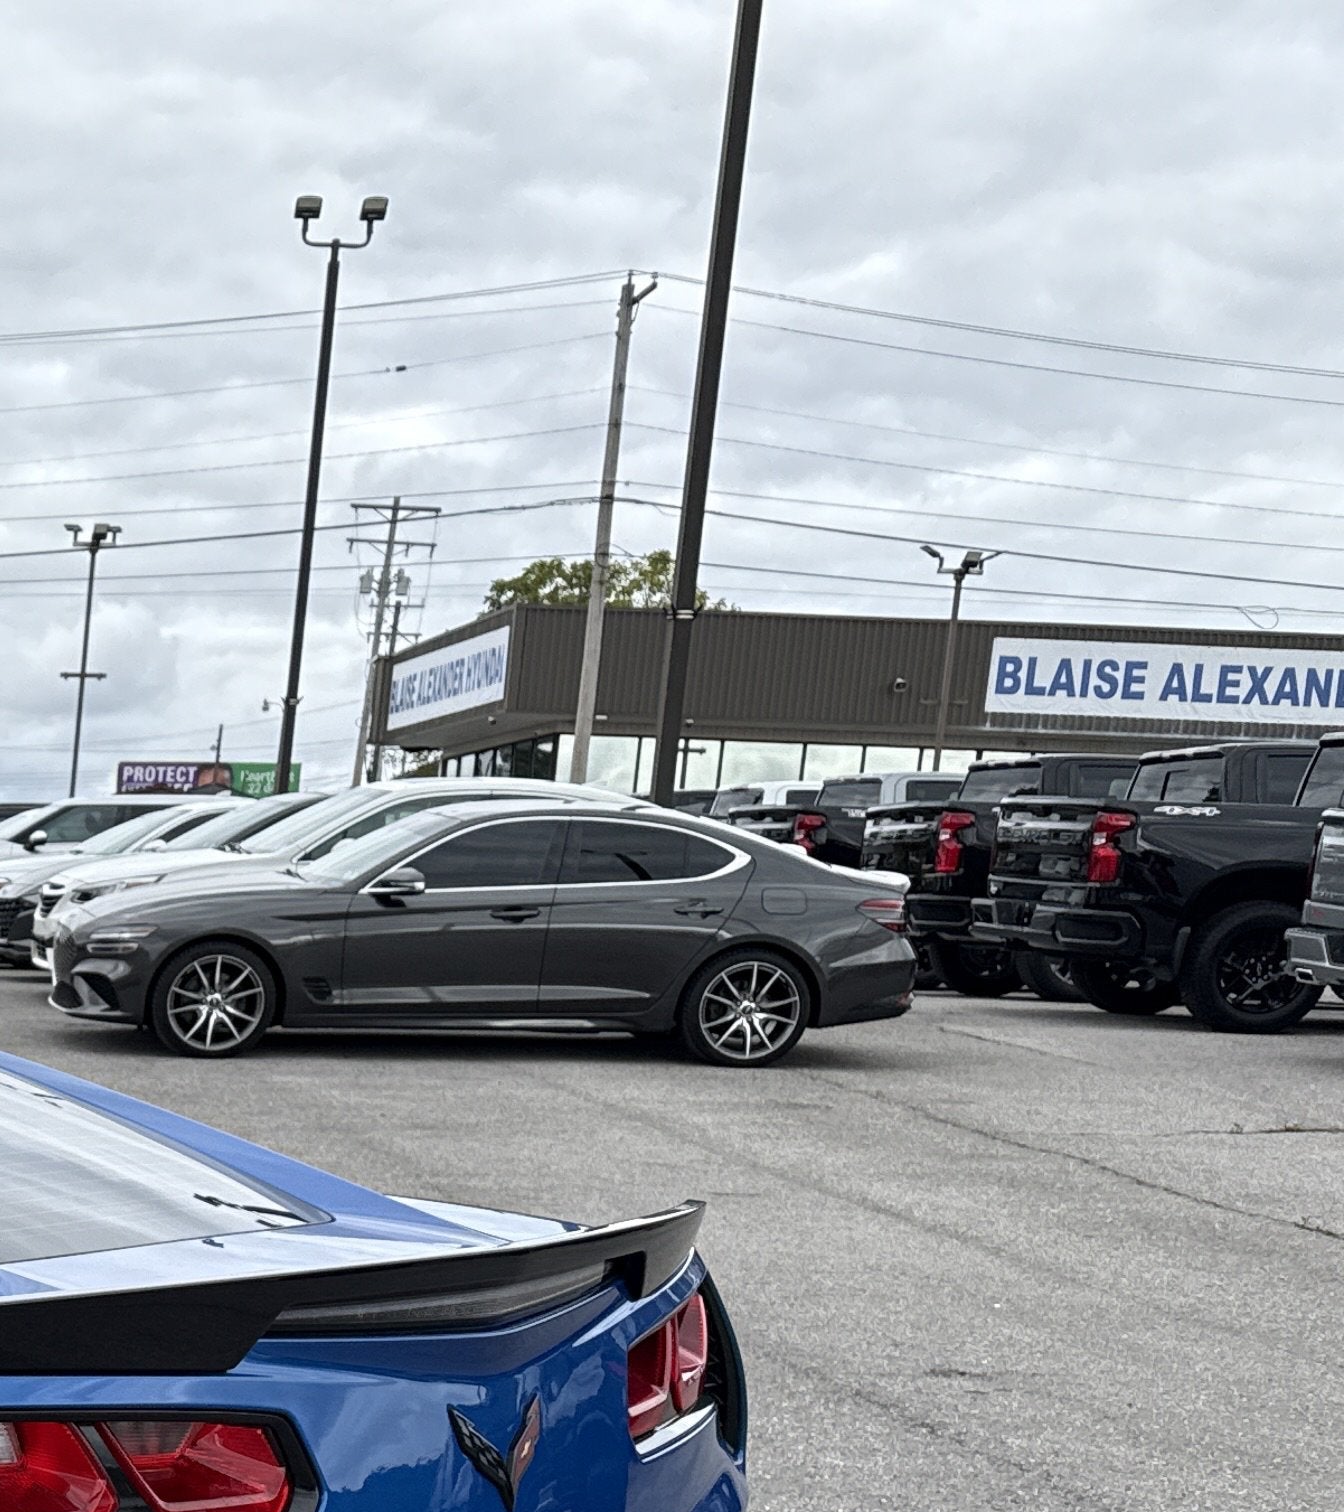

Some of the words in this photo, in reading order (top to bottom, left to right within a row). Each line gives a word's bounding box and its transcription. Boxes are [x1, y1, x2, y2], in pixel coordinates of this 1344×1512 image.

[389, 673, 418, 714] BLAISE
[994, 655, 1149, 700] BLAISE
[122, 765, 198, 783] PROTECT
